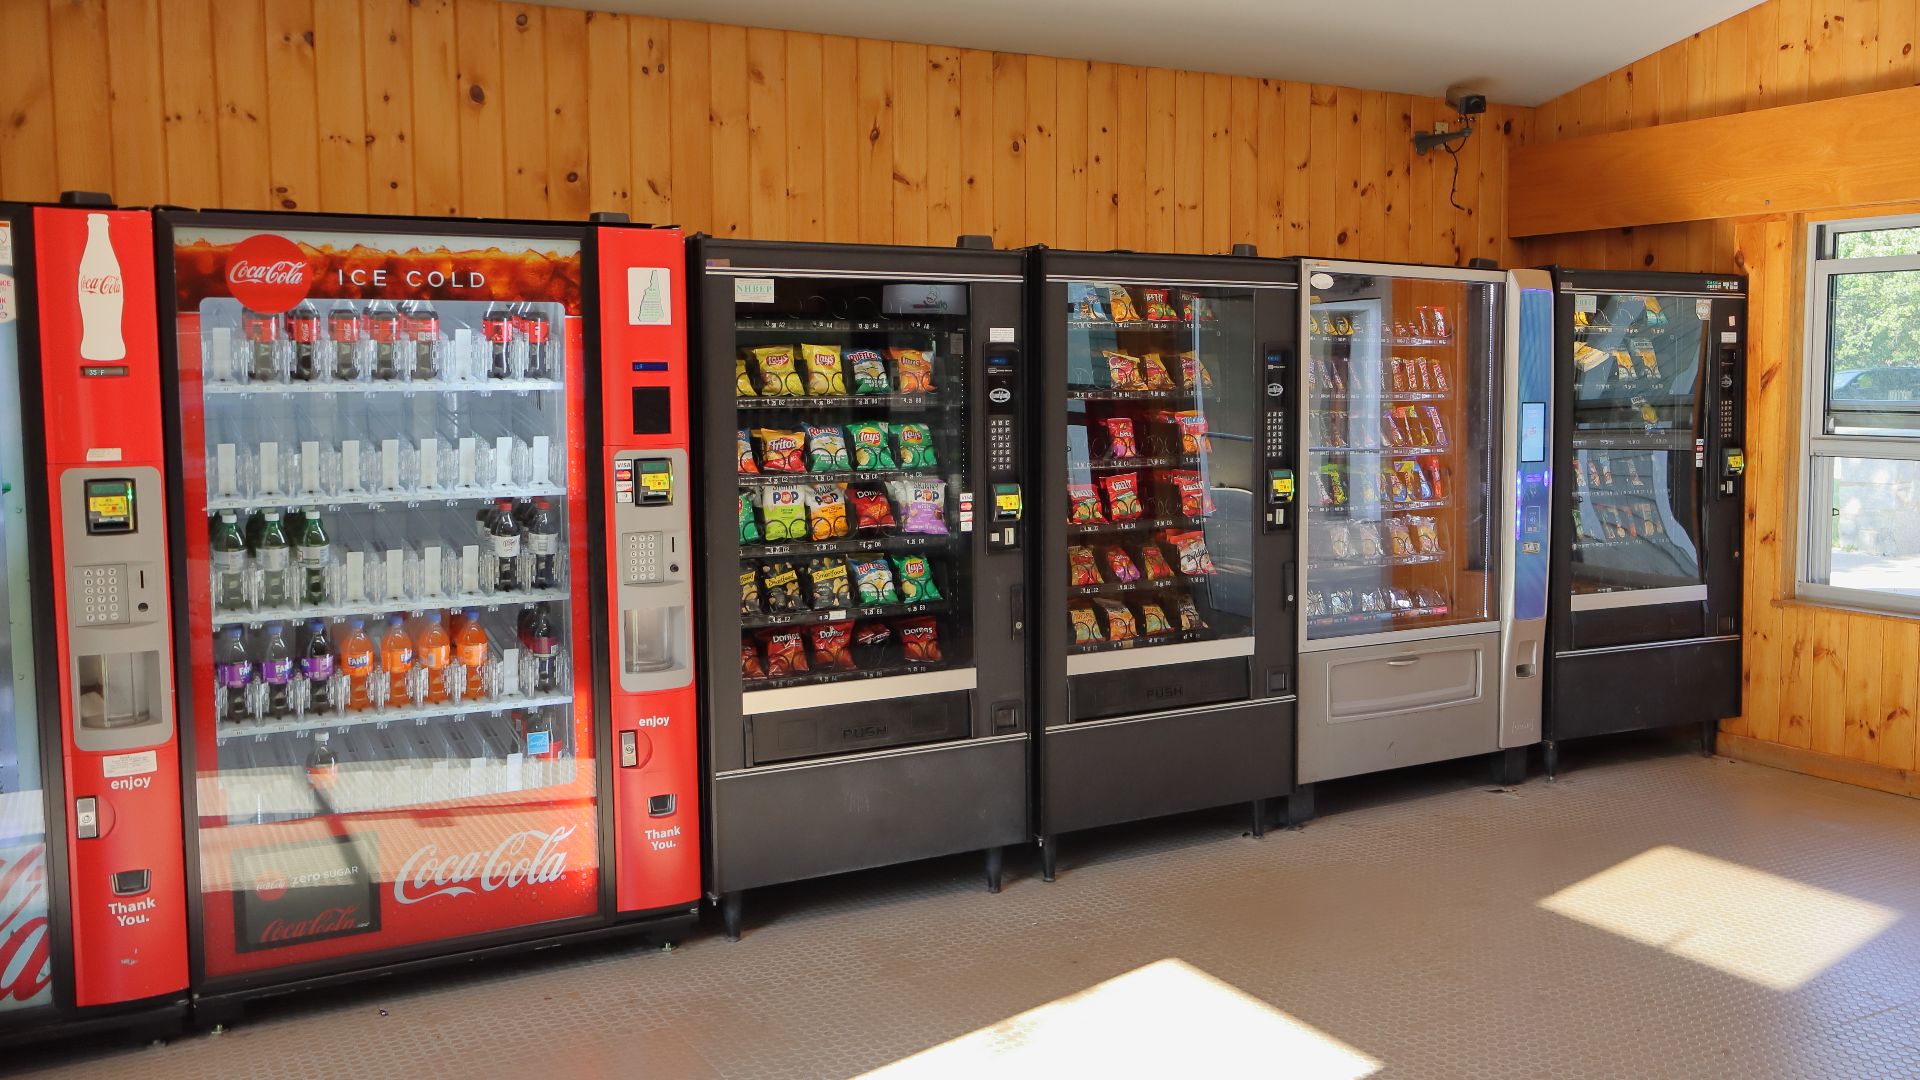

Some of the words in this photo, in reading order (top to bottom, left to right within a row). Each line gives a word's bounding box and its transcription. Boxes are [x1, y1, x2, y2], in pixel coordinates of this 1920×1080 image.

[229, 260, 308, 286] Coca-Cola
[338, 268, 387, 287] ICE
[405, 270, 486, 288] COLD
[773, 490, 799, 505] POP
[814, 492, 839, 505] POP
[914, 489, 940, 502] POP
[1146, 686, 1184, 699] PUSH
[638, 715, 670, 727] enjoy
[842, 725, 888, 740] PUSH
[110, 776, 152, 791] enjoy
[645, 825, 681, 841] Thank
[651, 839, 677, 851] You.
[393, 824, 577, 905] Coca-Cola
[291, 870, 321, 886] zero
[323, 865, 359, 880] SUGAR
[108, 897, 156, 915] Thank
[117, 914, 150, 927] You.
